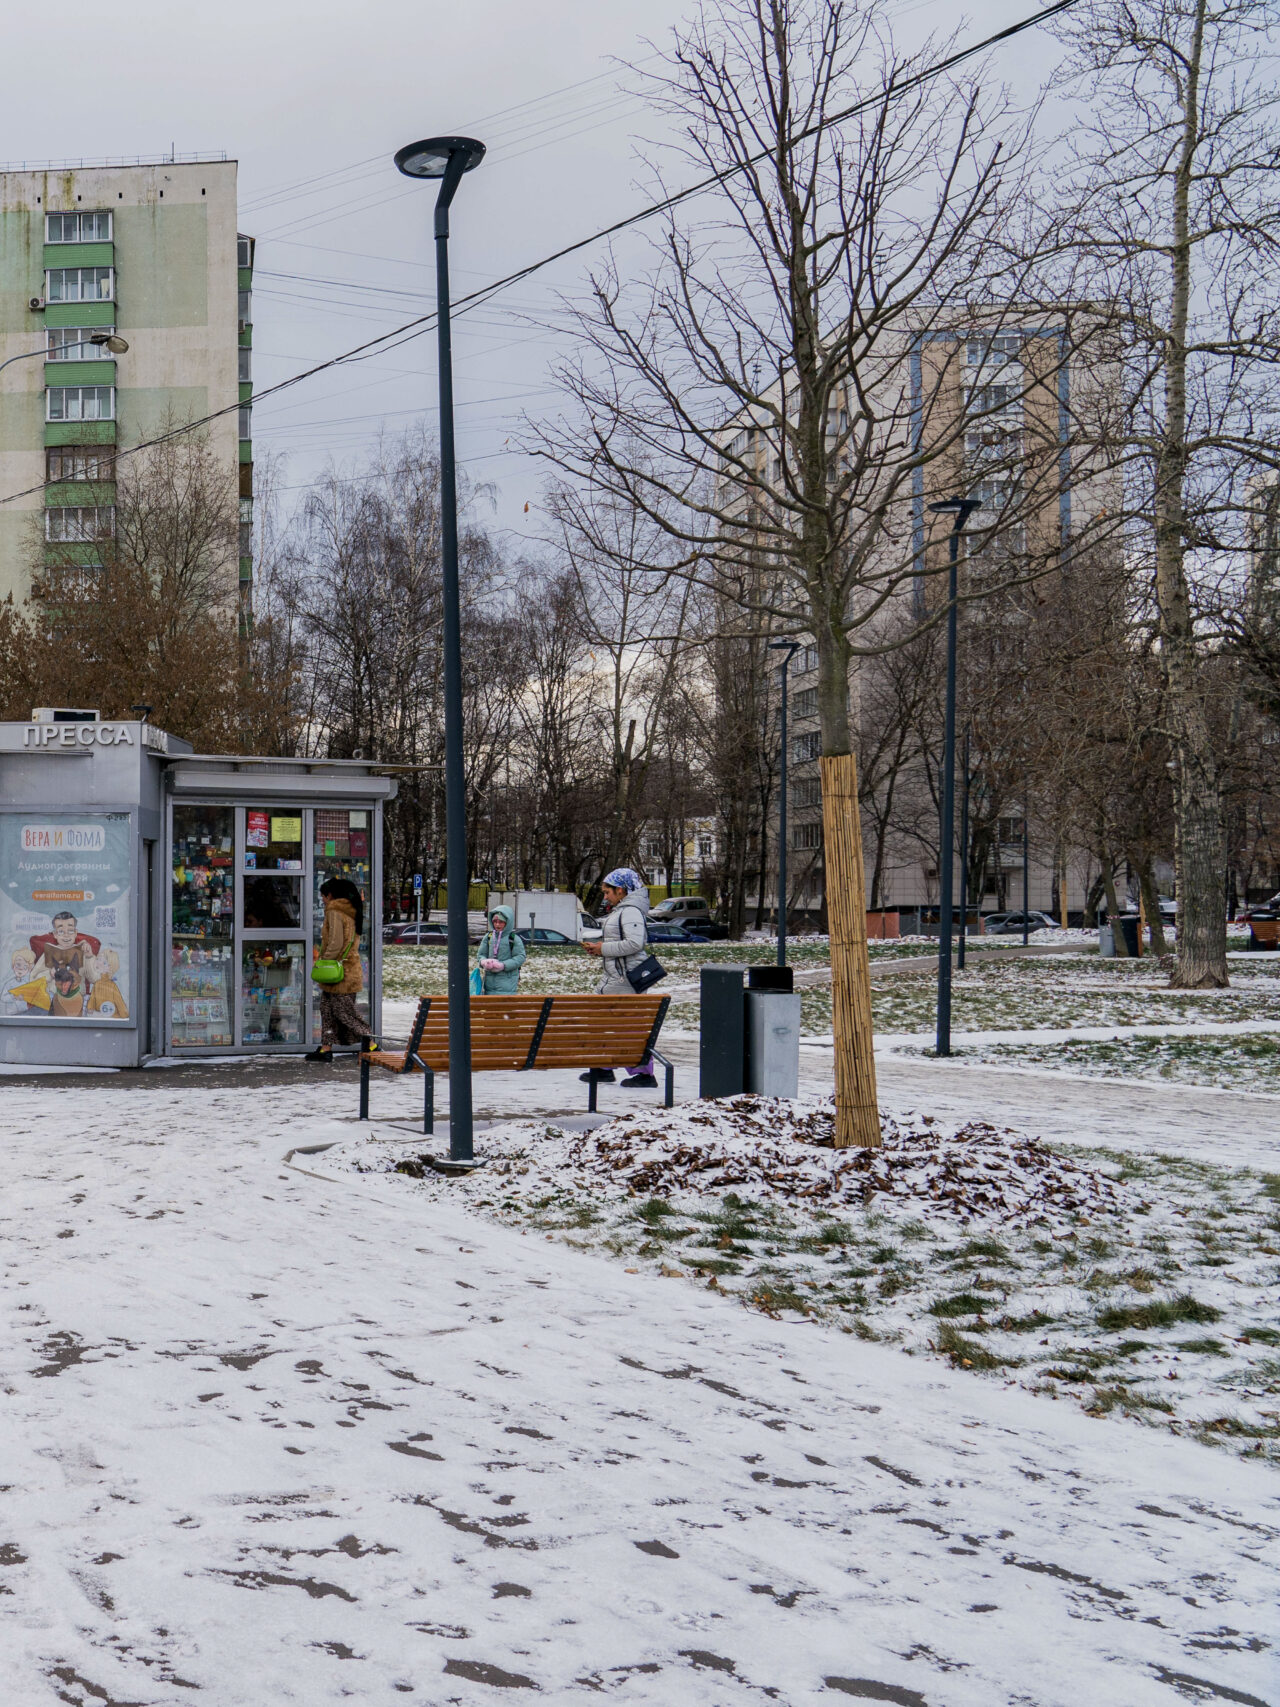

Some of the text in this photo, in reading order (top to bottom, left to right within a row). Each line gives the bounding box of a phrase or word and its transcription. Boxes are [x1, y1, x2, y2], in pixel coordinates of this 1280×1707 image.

[24, 724, 134, 746] ПРЕССА
[18, 861, 111, 872] Аудиопрограммы
[35, 873, 89, 883] для детей
[101, 1003, 114, 1013] 6+
